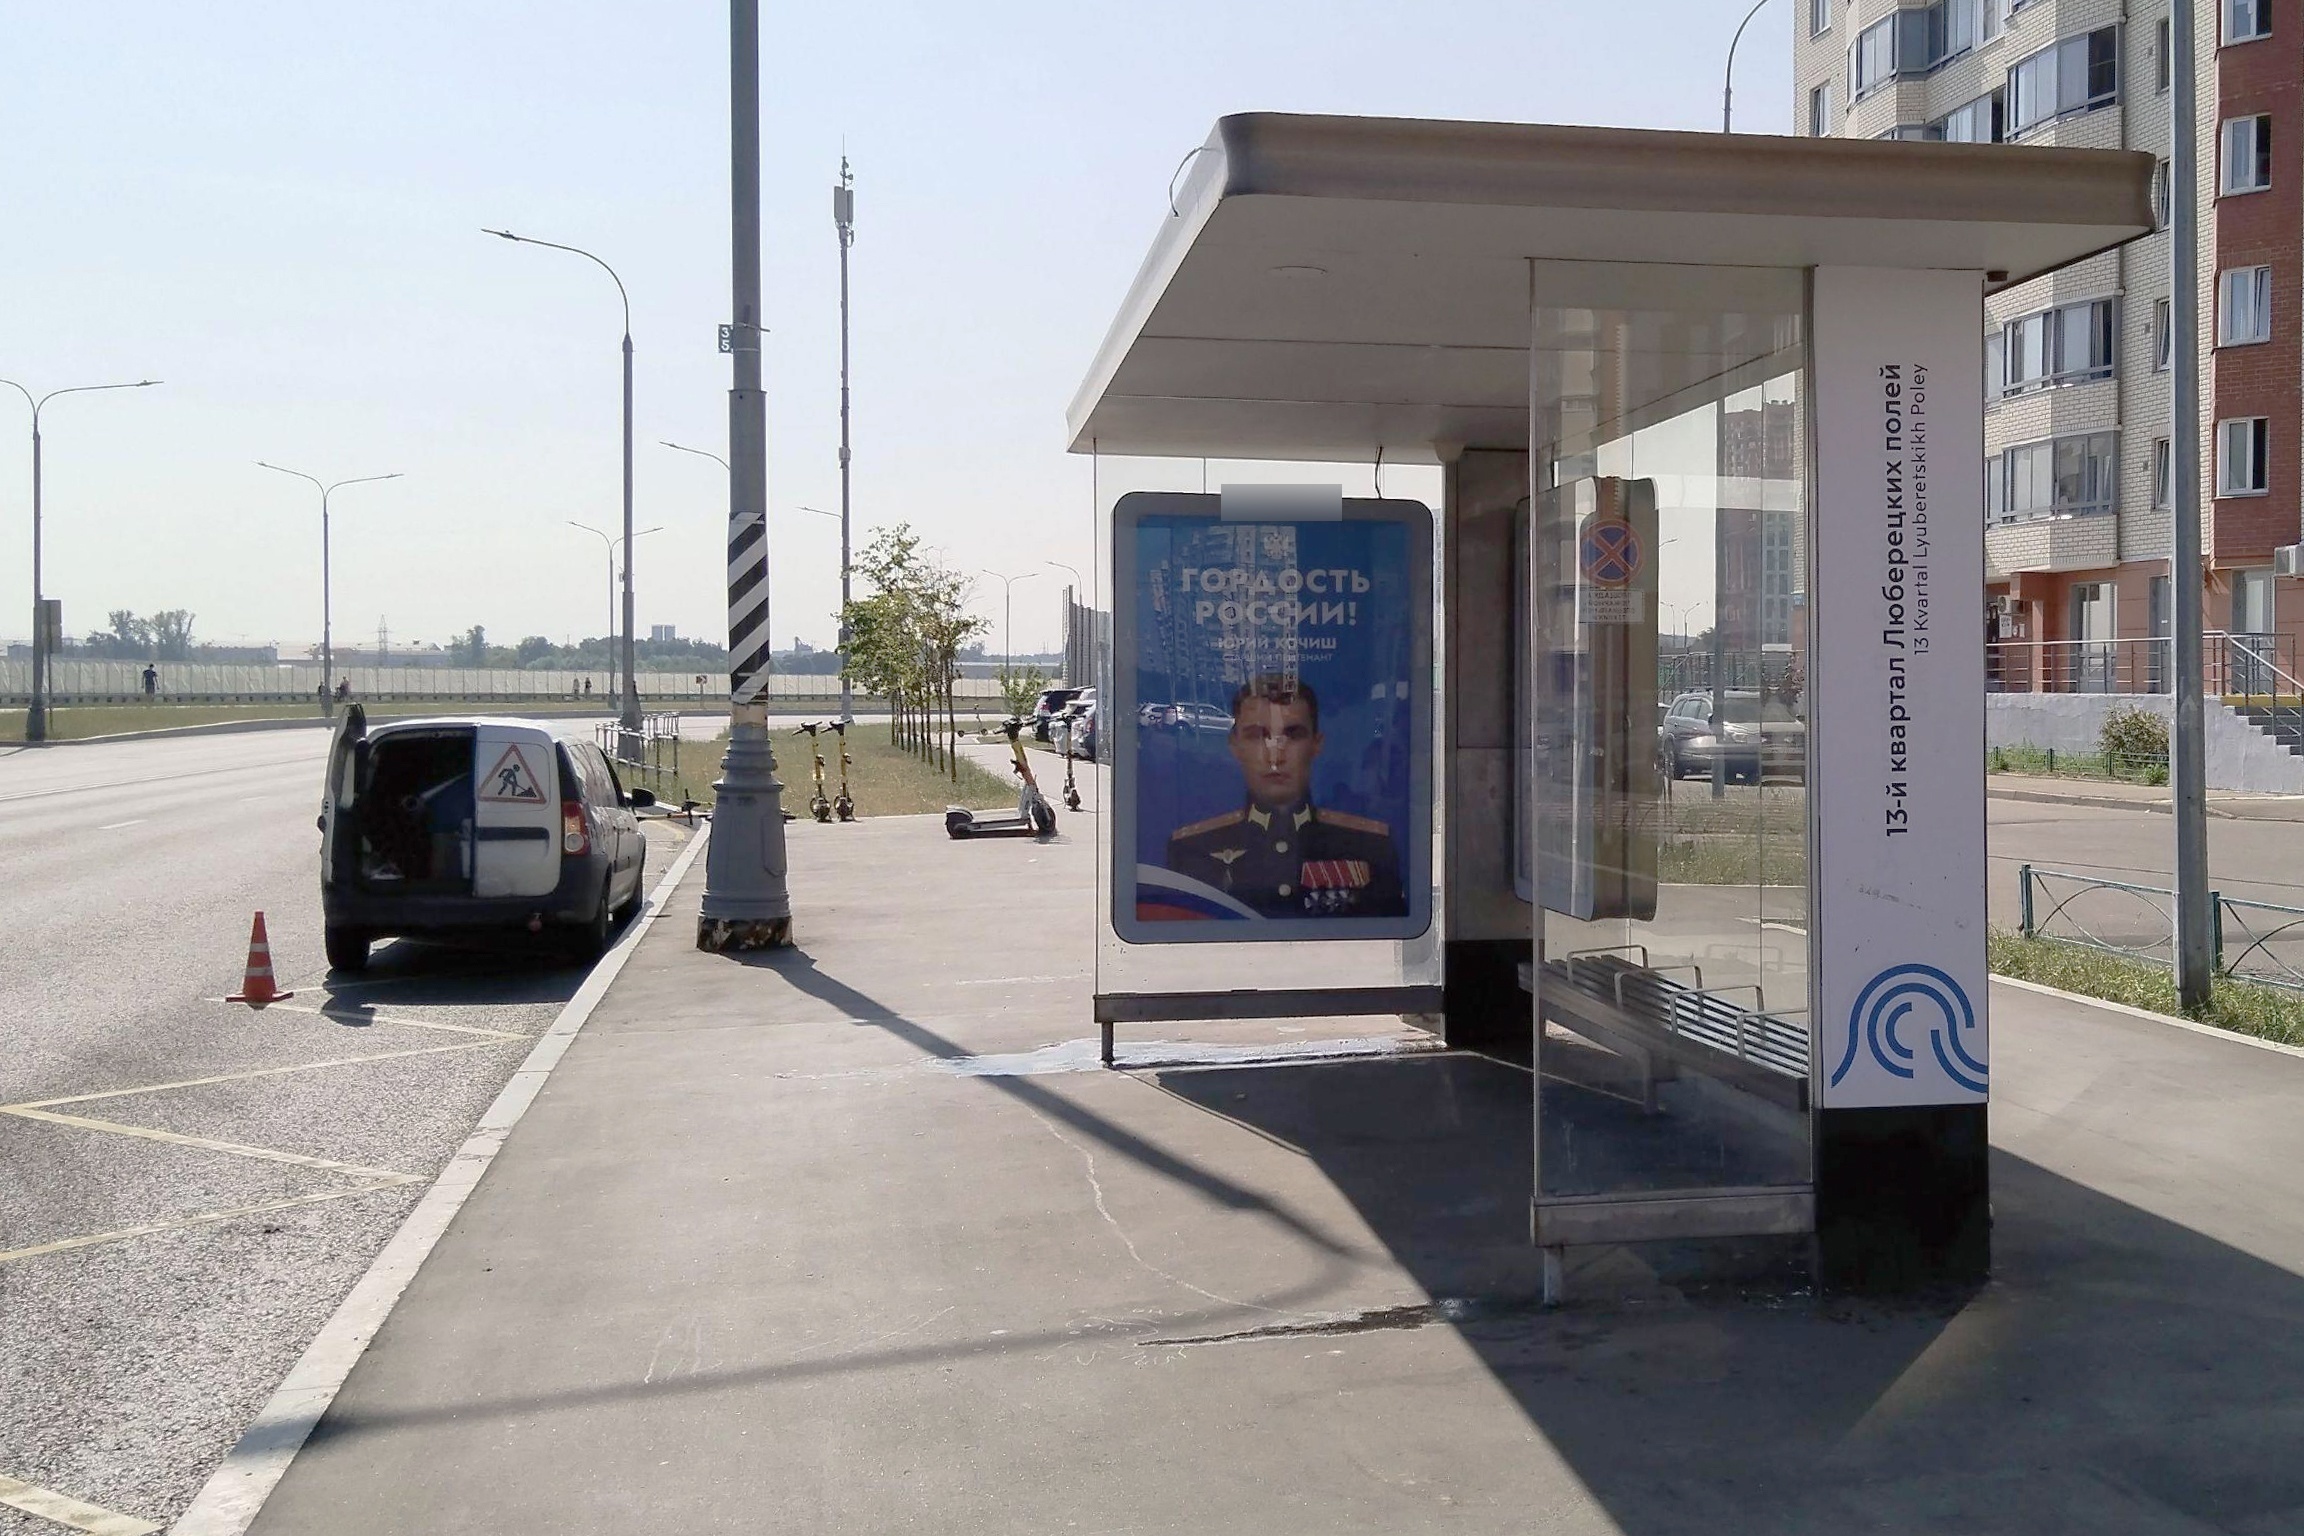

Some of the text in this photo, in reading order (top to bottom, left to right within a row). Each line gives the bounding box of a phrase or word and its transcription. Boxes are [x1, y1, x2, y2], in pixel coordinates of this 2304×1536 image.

[1909, 363, 1931, 656] 13 Kvartal Lyuberetskikh Poley
[1181, 568, 1370, 596] ГОРДОСТЬ
[1195, 600, 1357, 626] РОССИИ!
[1879, 364, 1911, 837] 13-й квартал Люберецких полей
[1275, 637, 1337, 650] КОЧИШ
